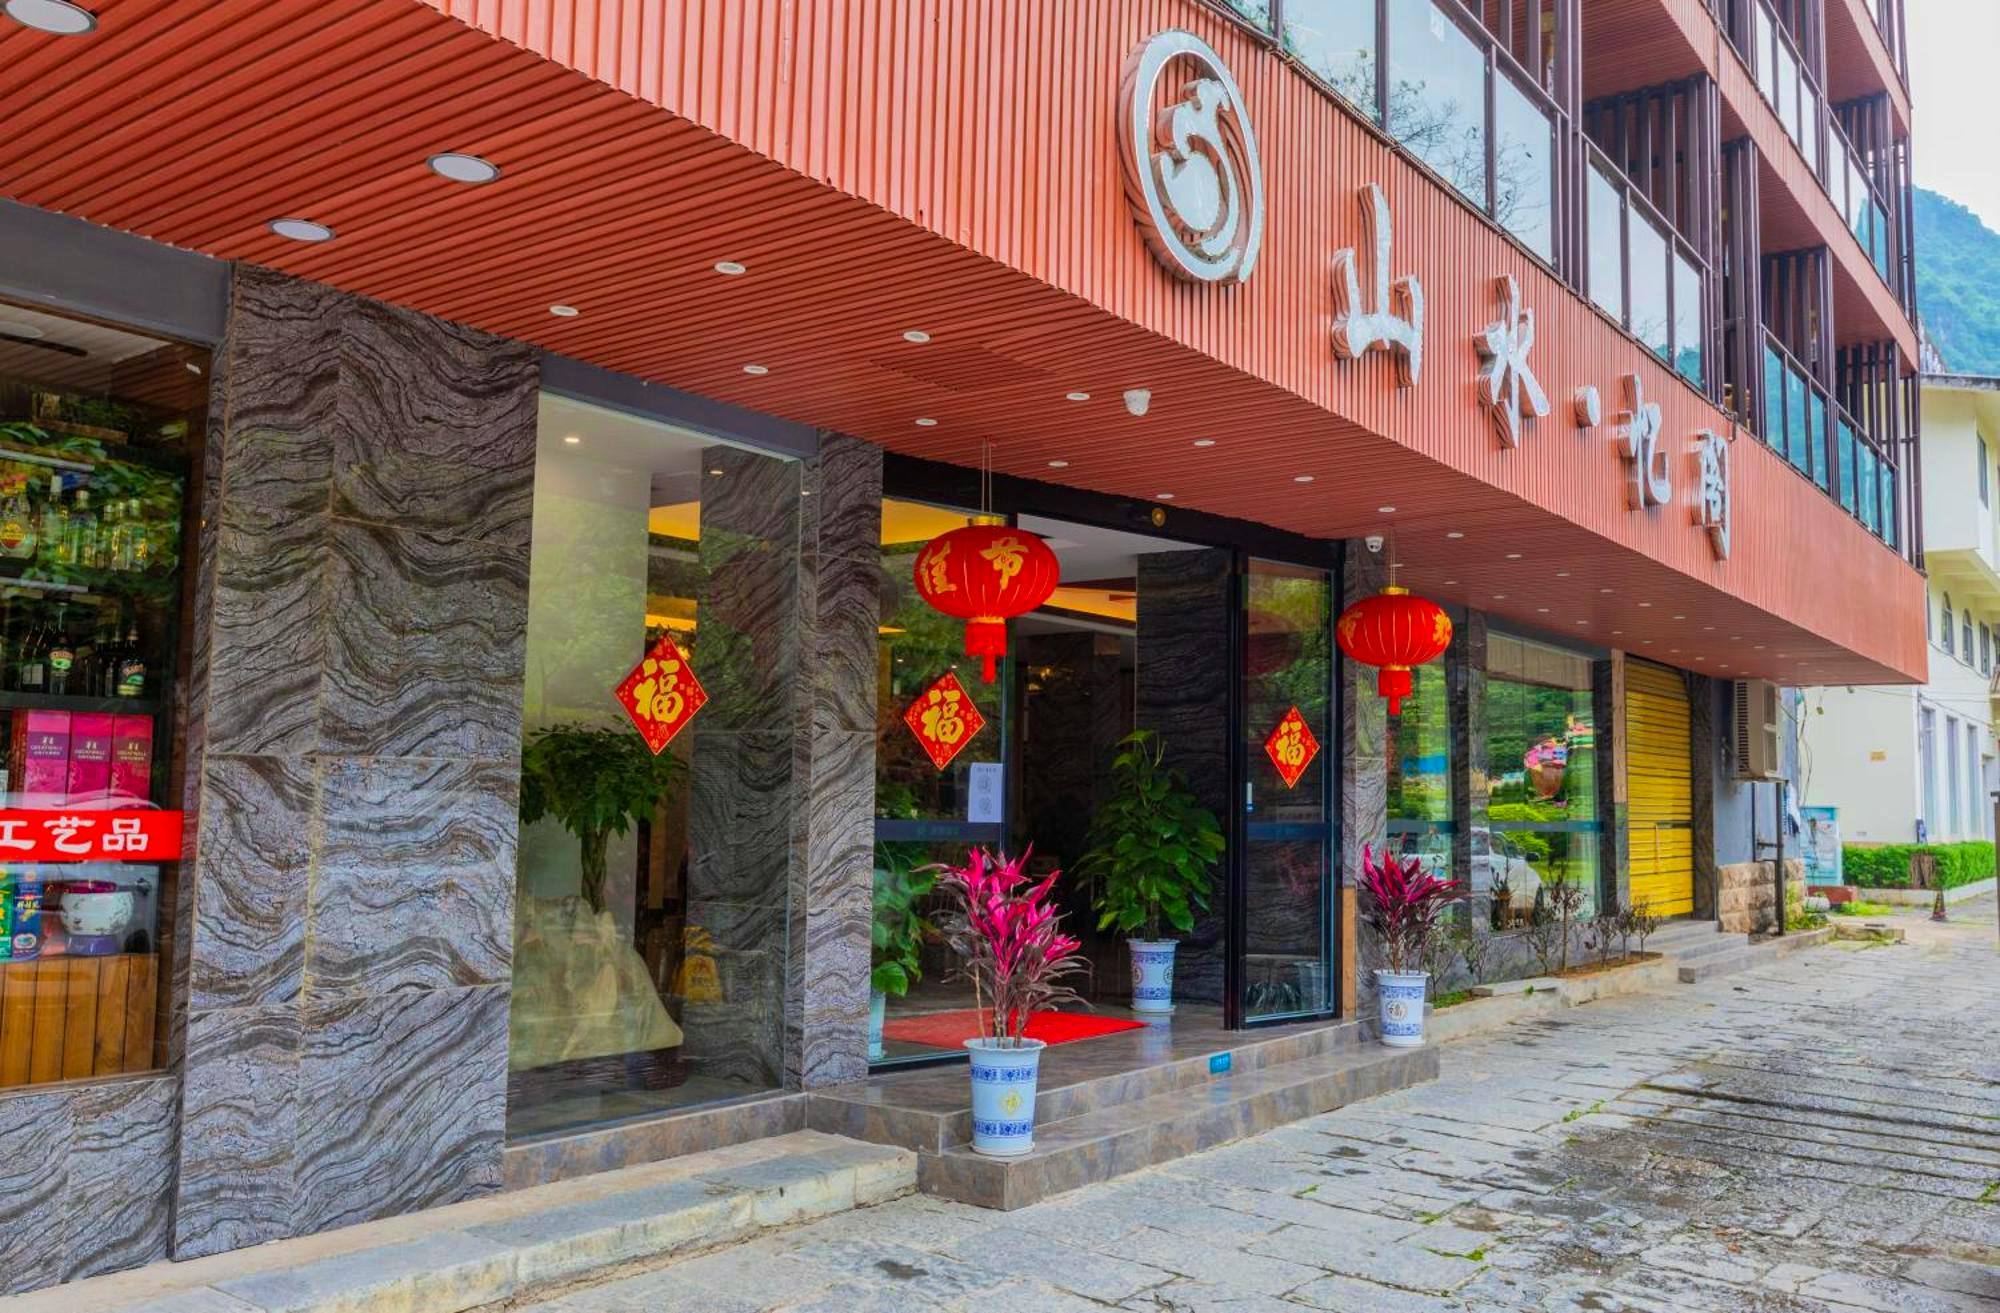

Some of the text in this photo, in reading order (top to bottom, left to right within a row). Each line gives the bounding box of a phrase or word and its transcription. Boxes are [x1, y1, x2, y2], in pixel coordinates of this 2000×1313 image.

[632, 657, 685, 724] 福
[920, 688, 965, 745] 福
[1274, 720, 1306, 767] 福
[0, 816, 149, 854] 工艺品
